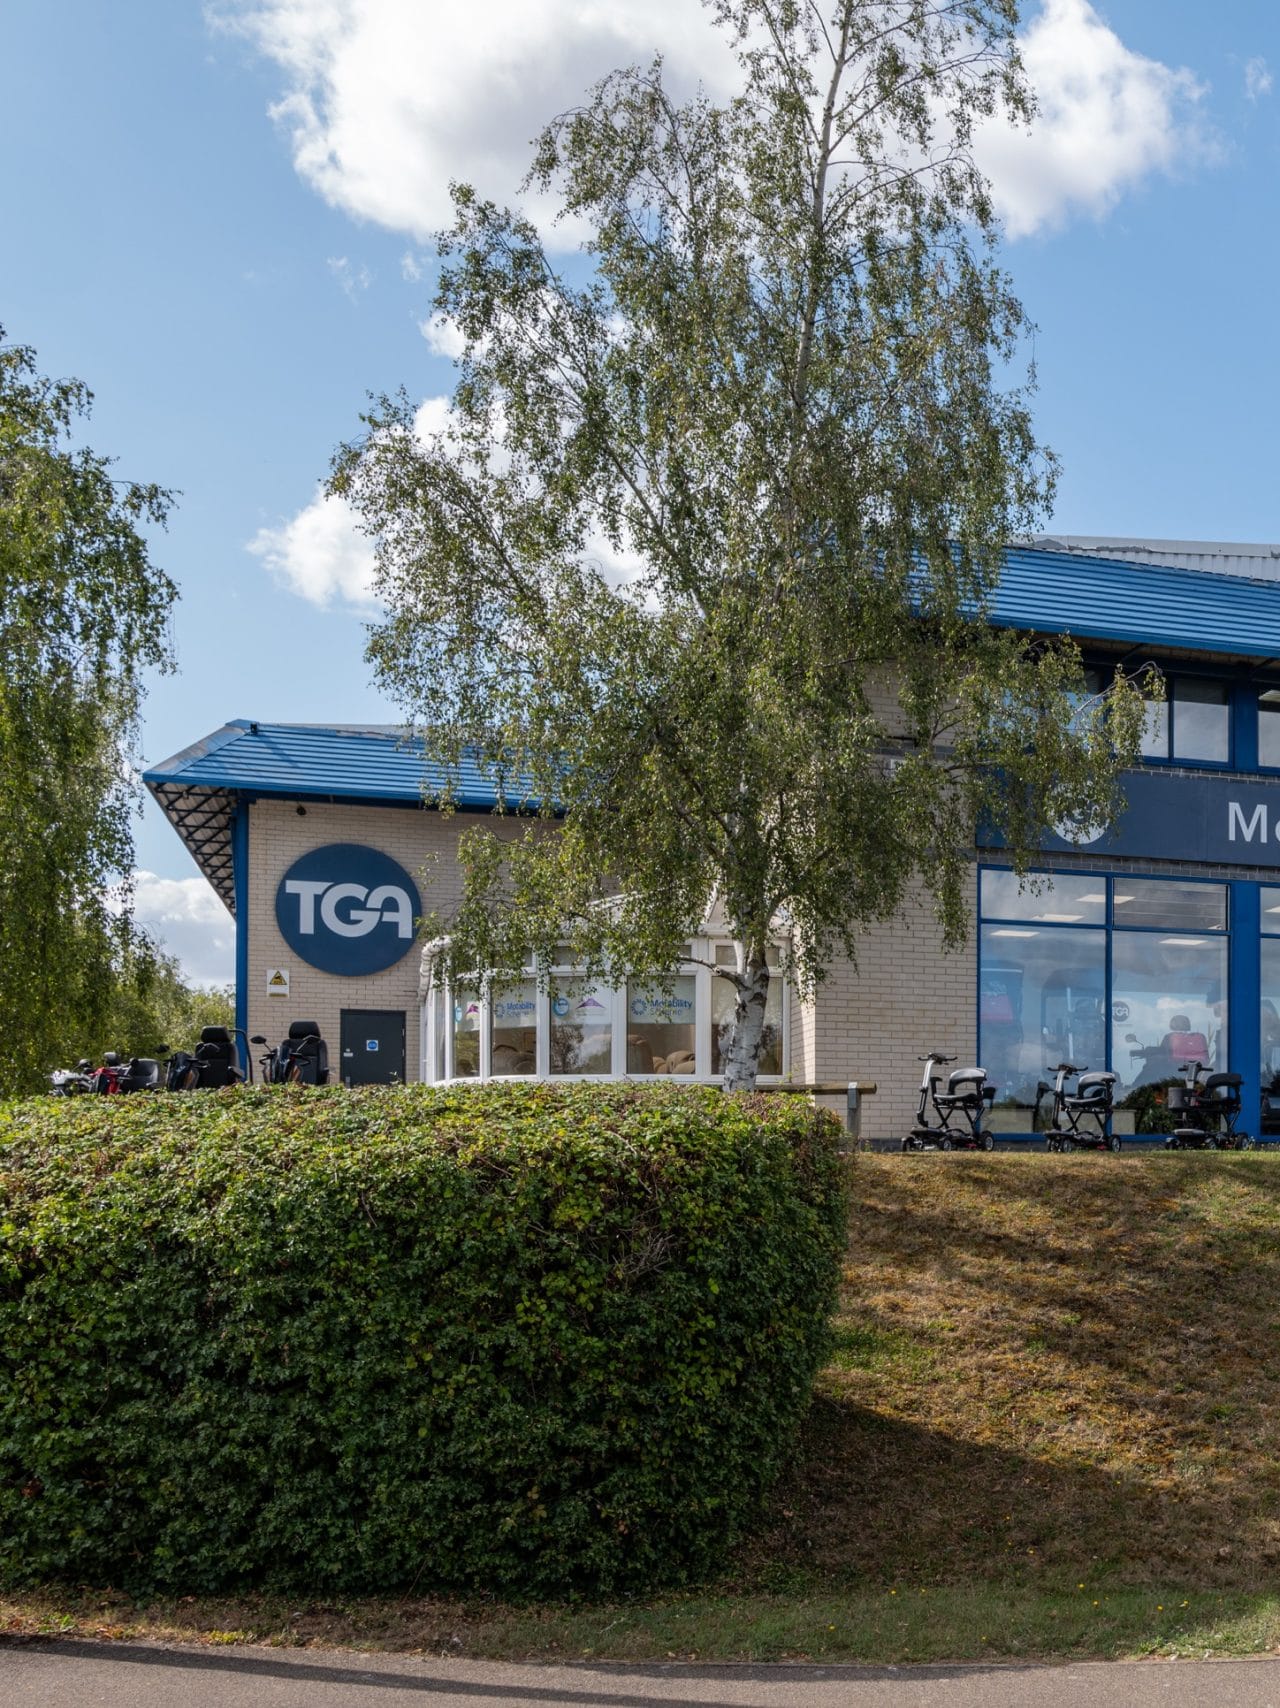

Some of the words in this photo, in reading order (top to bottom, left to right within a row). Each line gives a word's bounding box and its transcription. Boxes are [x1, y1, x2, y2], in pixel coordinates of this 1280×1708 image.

[285, 879, 413, 939] TGA
[506, 1001, 536, 1011] Motability
[650, 998, 693, 1009] Moability
